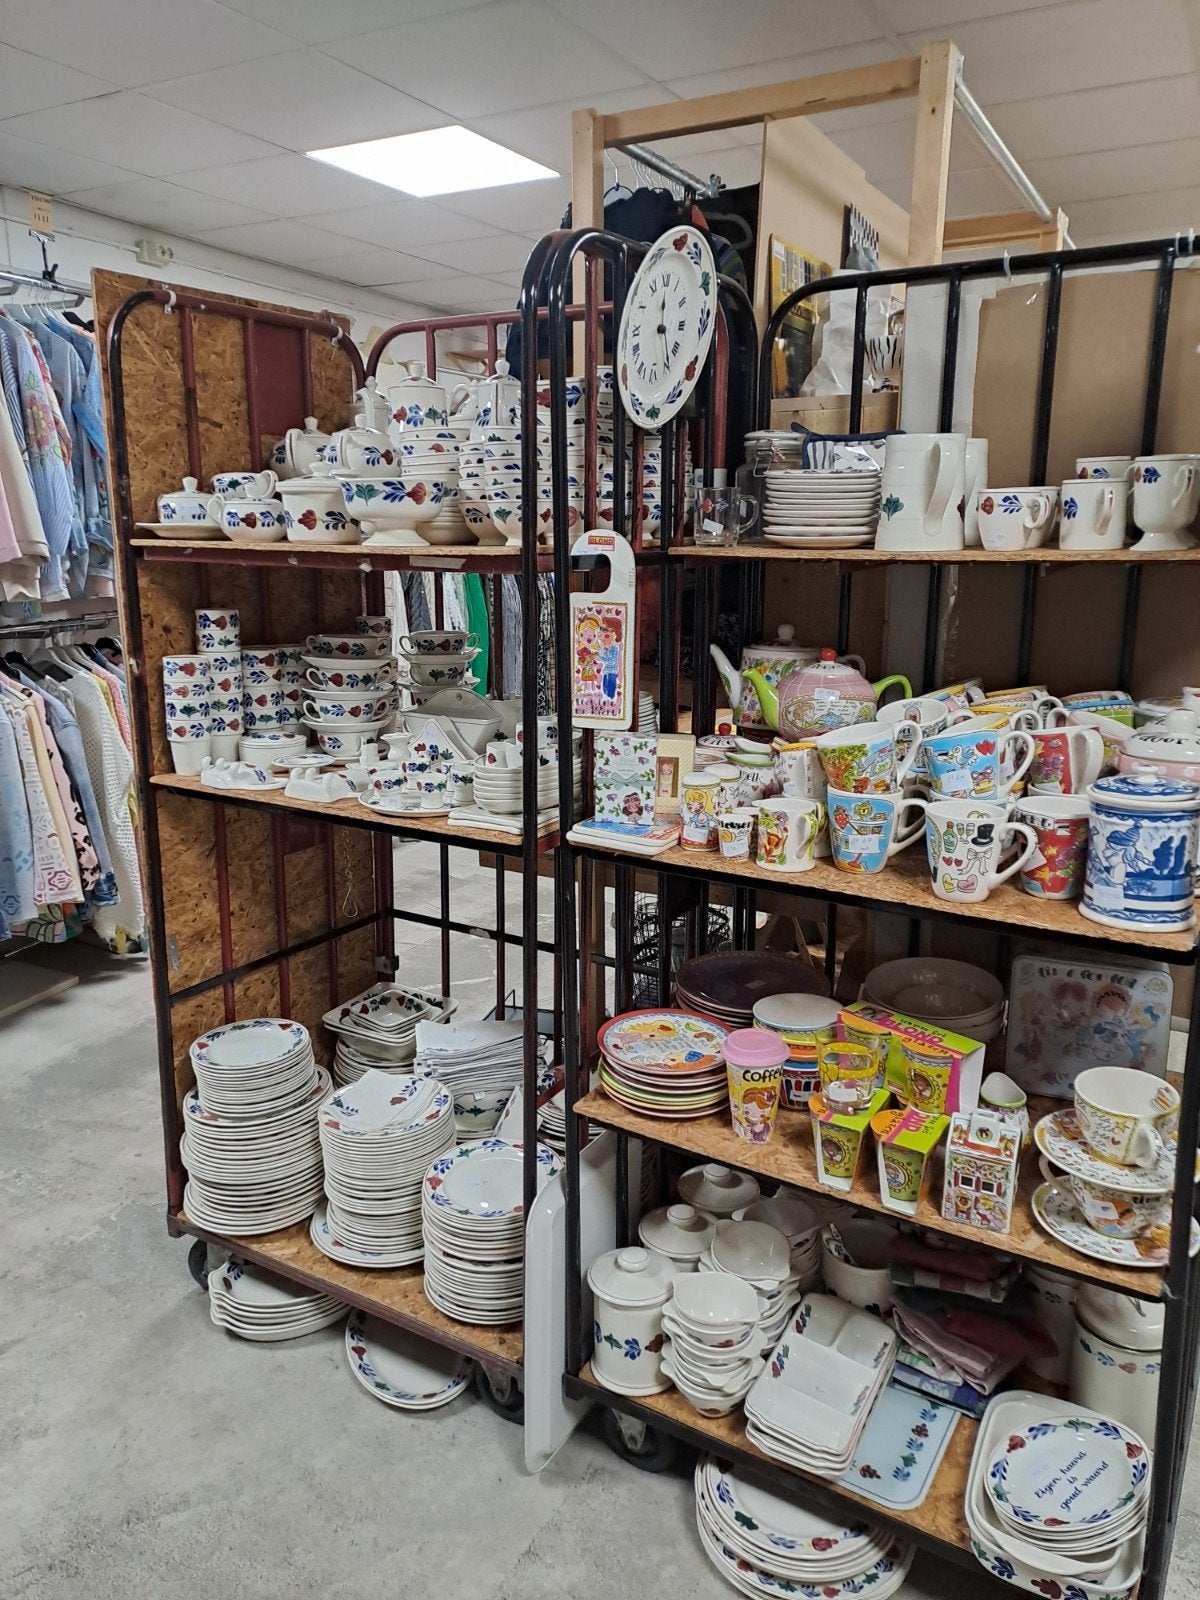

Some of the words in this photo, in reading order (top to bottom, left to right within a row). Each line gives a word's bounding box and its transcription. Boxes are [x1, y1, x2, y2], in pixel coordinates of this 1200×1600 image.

[1034, 1476, 1062, 1499] Eigen
[1060, 1451, 1087, 1475] haard
[1060, 1486, 1083, 1513] goud
[1081, 1460, 1110, 1487] waard
[1066, 1475, 1078, 1484] is
